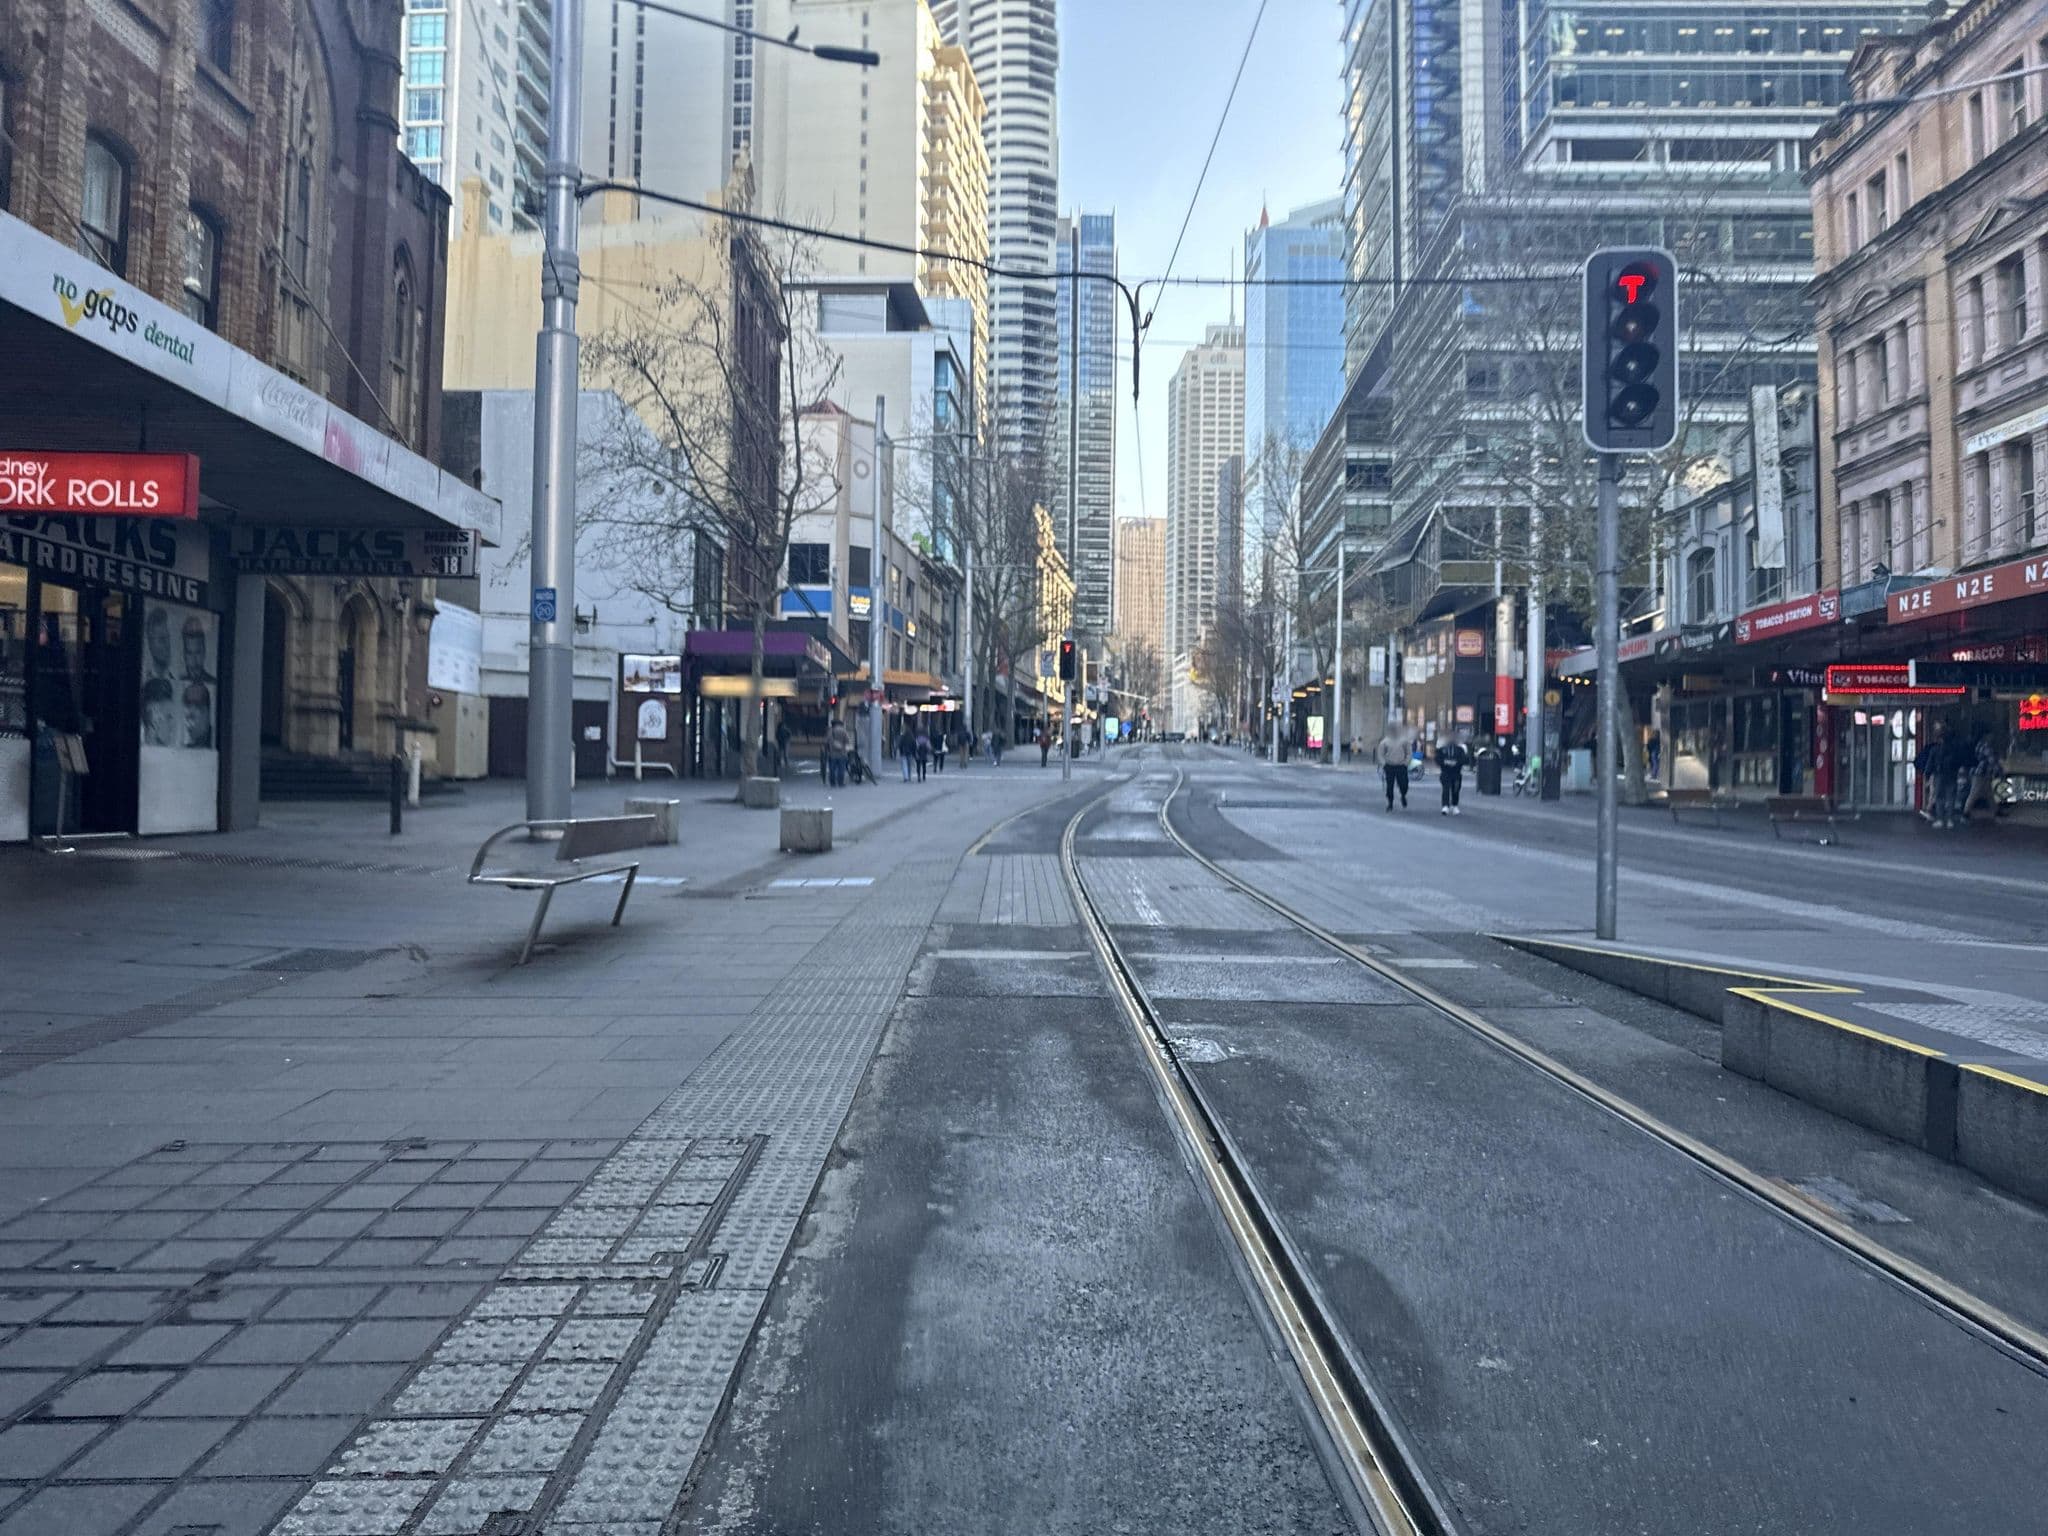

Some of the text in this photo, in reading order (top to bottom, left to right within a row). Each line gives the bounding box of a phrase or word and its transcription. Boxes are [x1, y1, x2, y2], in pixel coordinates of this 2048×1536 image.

[52, 273, 195, 365] no gaps dental
[67, 479, 159, 508] ROLLS
[236, 528, 405, 560] JACKS
[1755, 613, 1784, 630] TOBACCO
[1785, 604, 1813, 623] STATION
[1952, 645, 2005, 662] TOBACCO
[1857, 674, 1908, 684] TOBACCO
